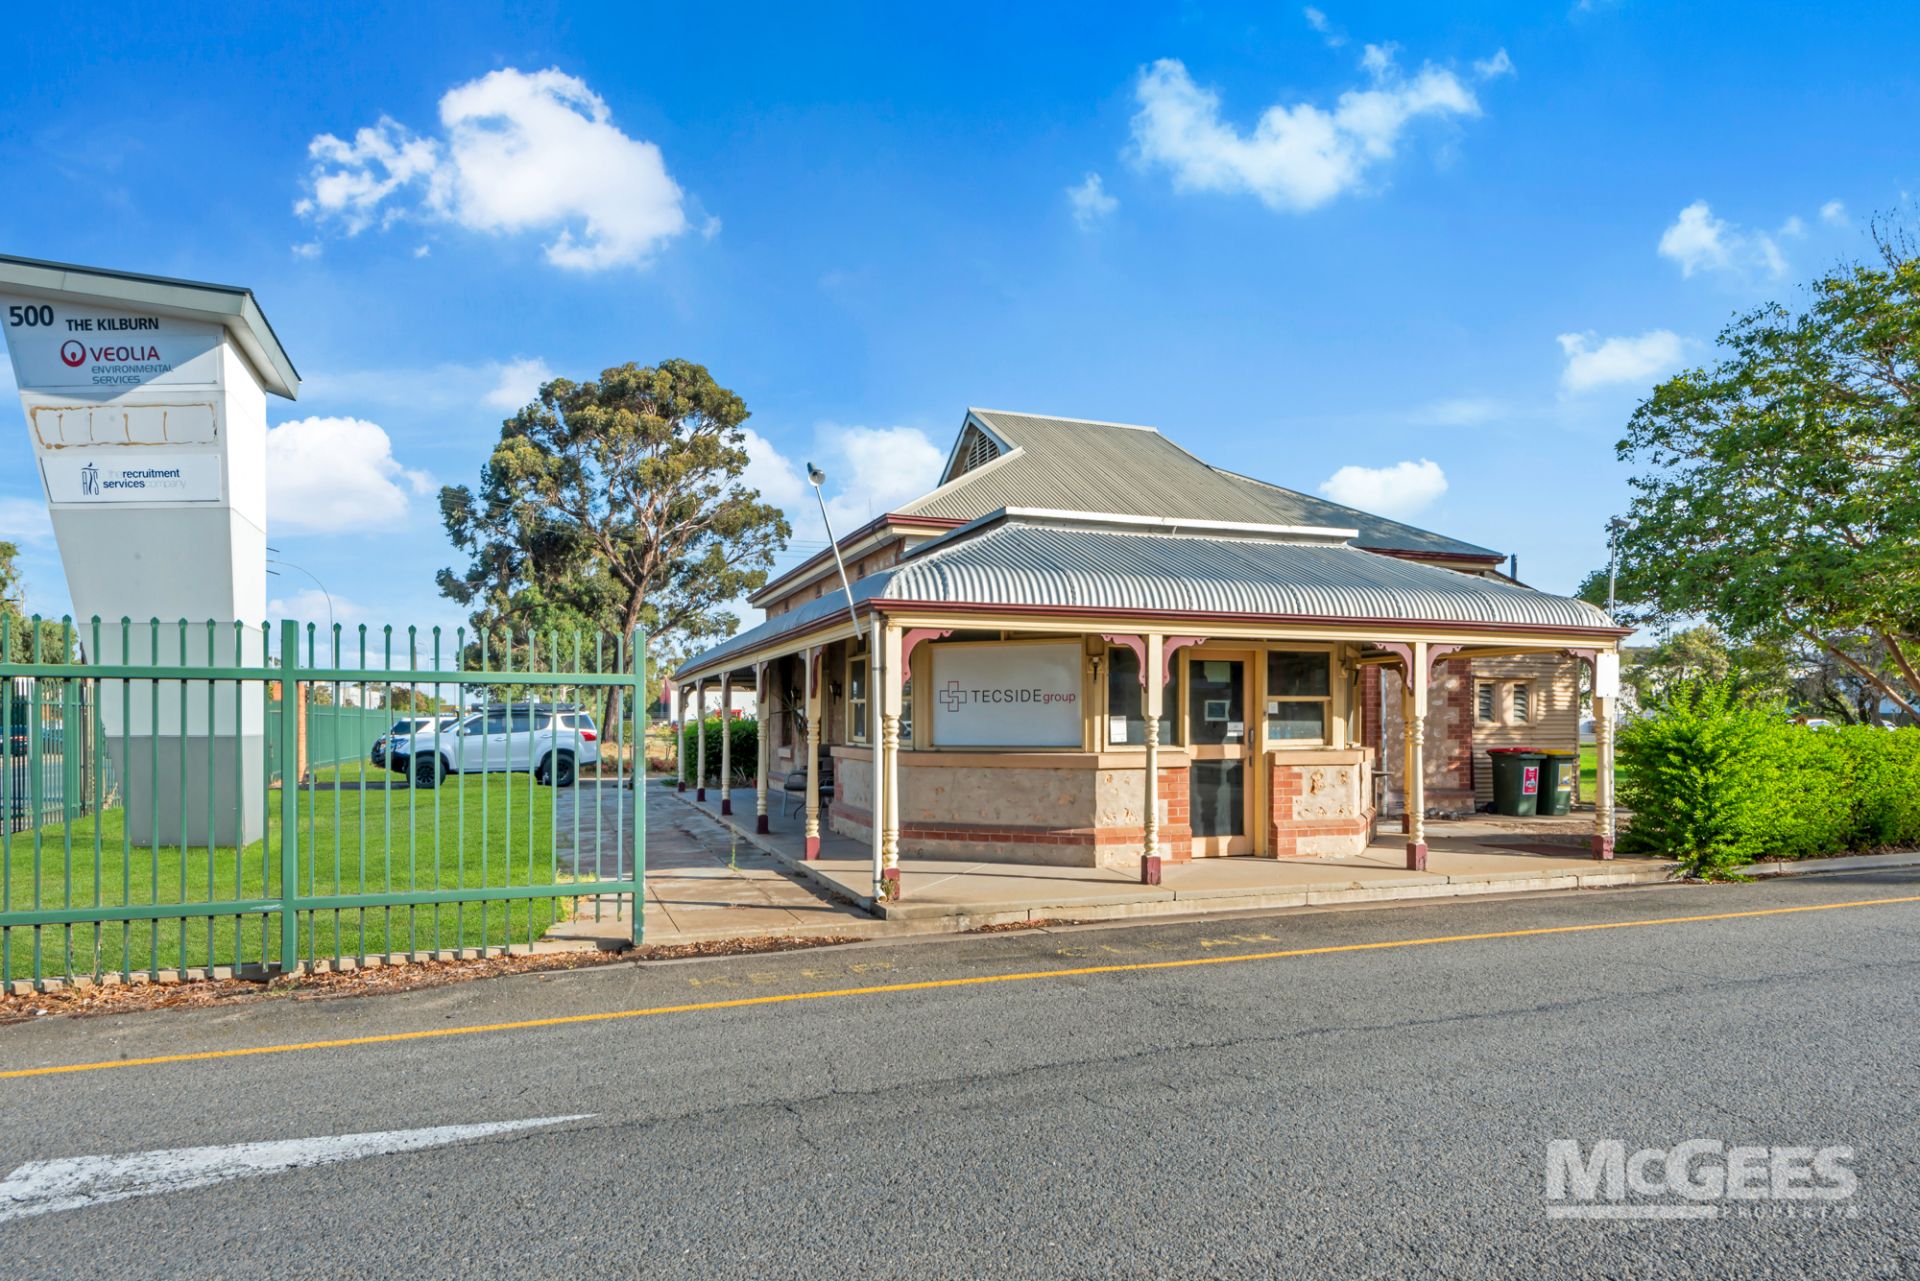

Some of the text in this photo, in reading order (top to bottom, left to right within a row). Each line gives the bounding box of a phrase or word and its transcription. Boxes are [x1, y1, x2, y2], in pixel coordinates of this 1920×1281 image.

[9, 305, 54, 327] 500
[66, 317, 159, 331] THE KILBURN
[90, 346, 160, 362] VEOLIA
[91, 364, 174, 374] ENVIRONMENTAL
[92, 375, 141, 384] SERVICES
